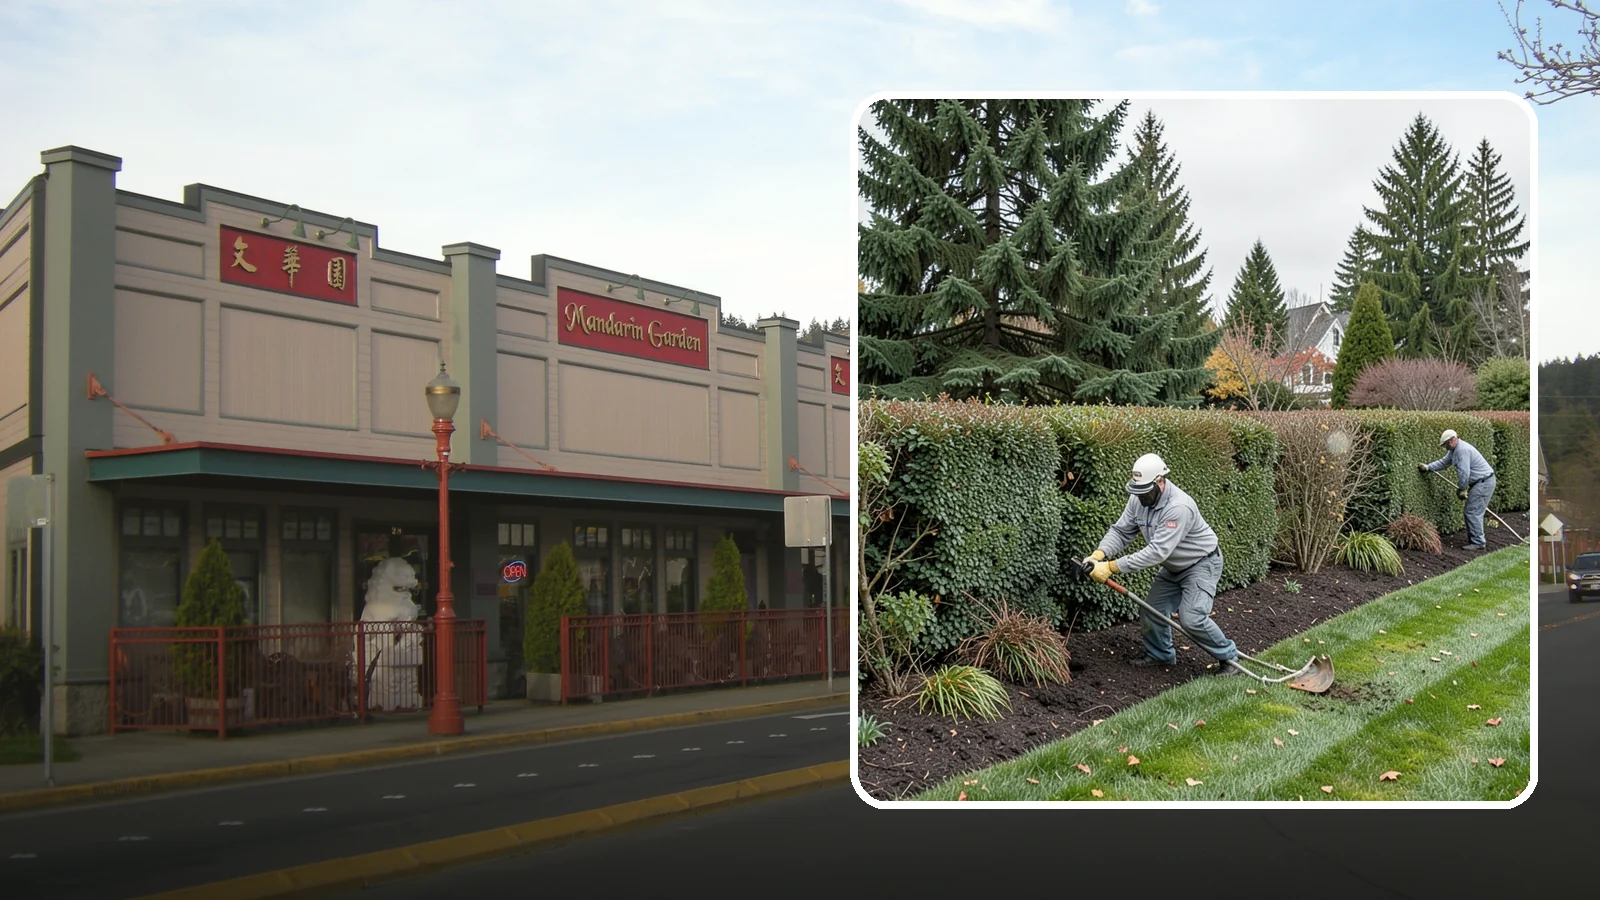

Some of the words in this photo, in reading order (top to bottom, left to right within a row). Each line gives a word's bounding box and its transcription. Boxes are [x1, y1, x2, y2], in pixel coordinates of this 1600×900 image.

[565, 302, 644, 341] Mandarin
[648, 320, 701, 352] Garden
[503, 565, 526, 578] OPEN
